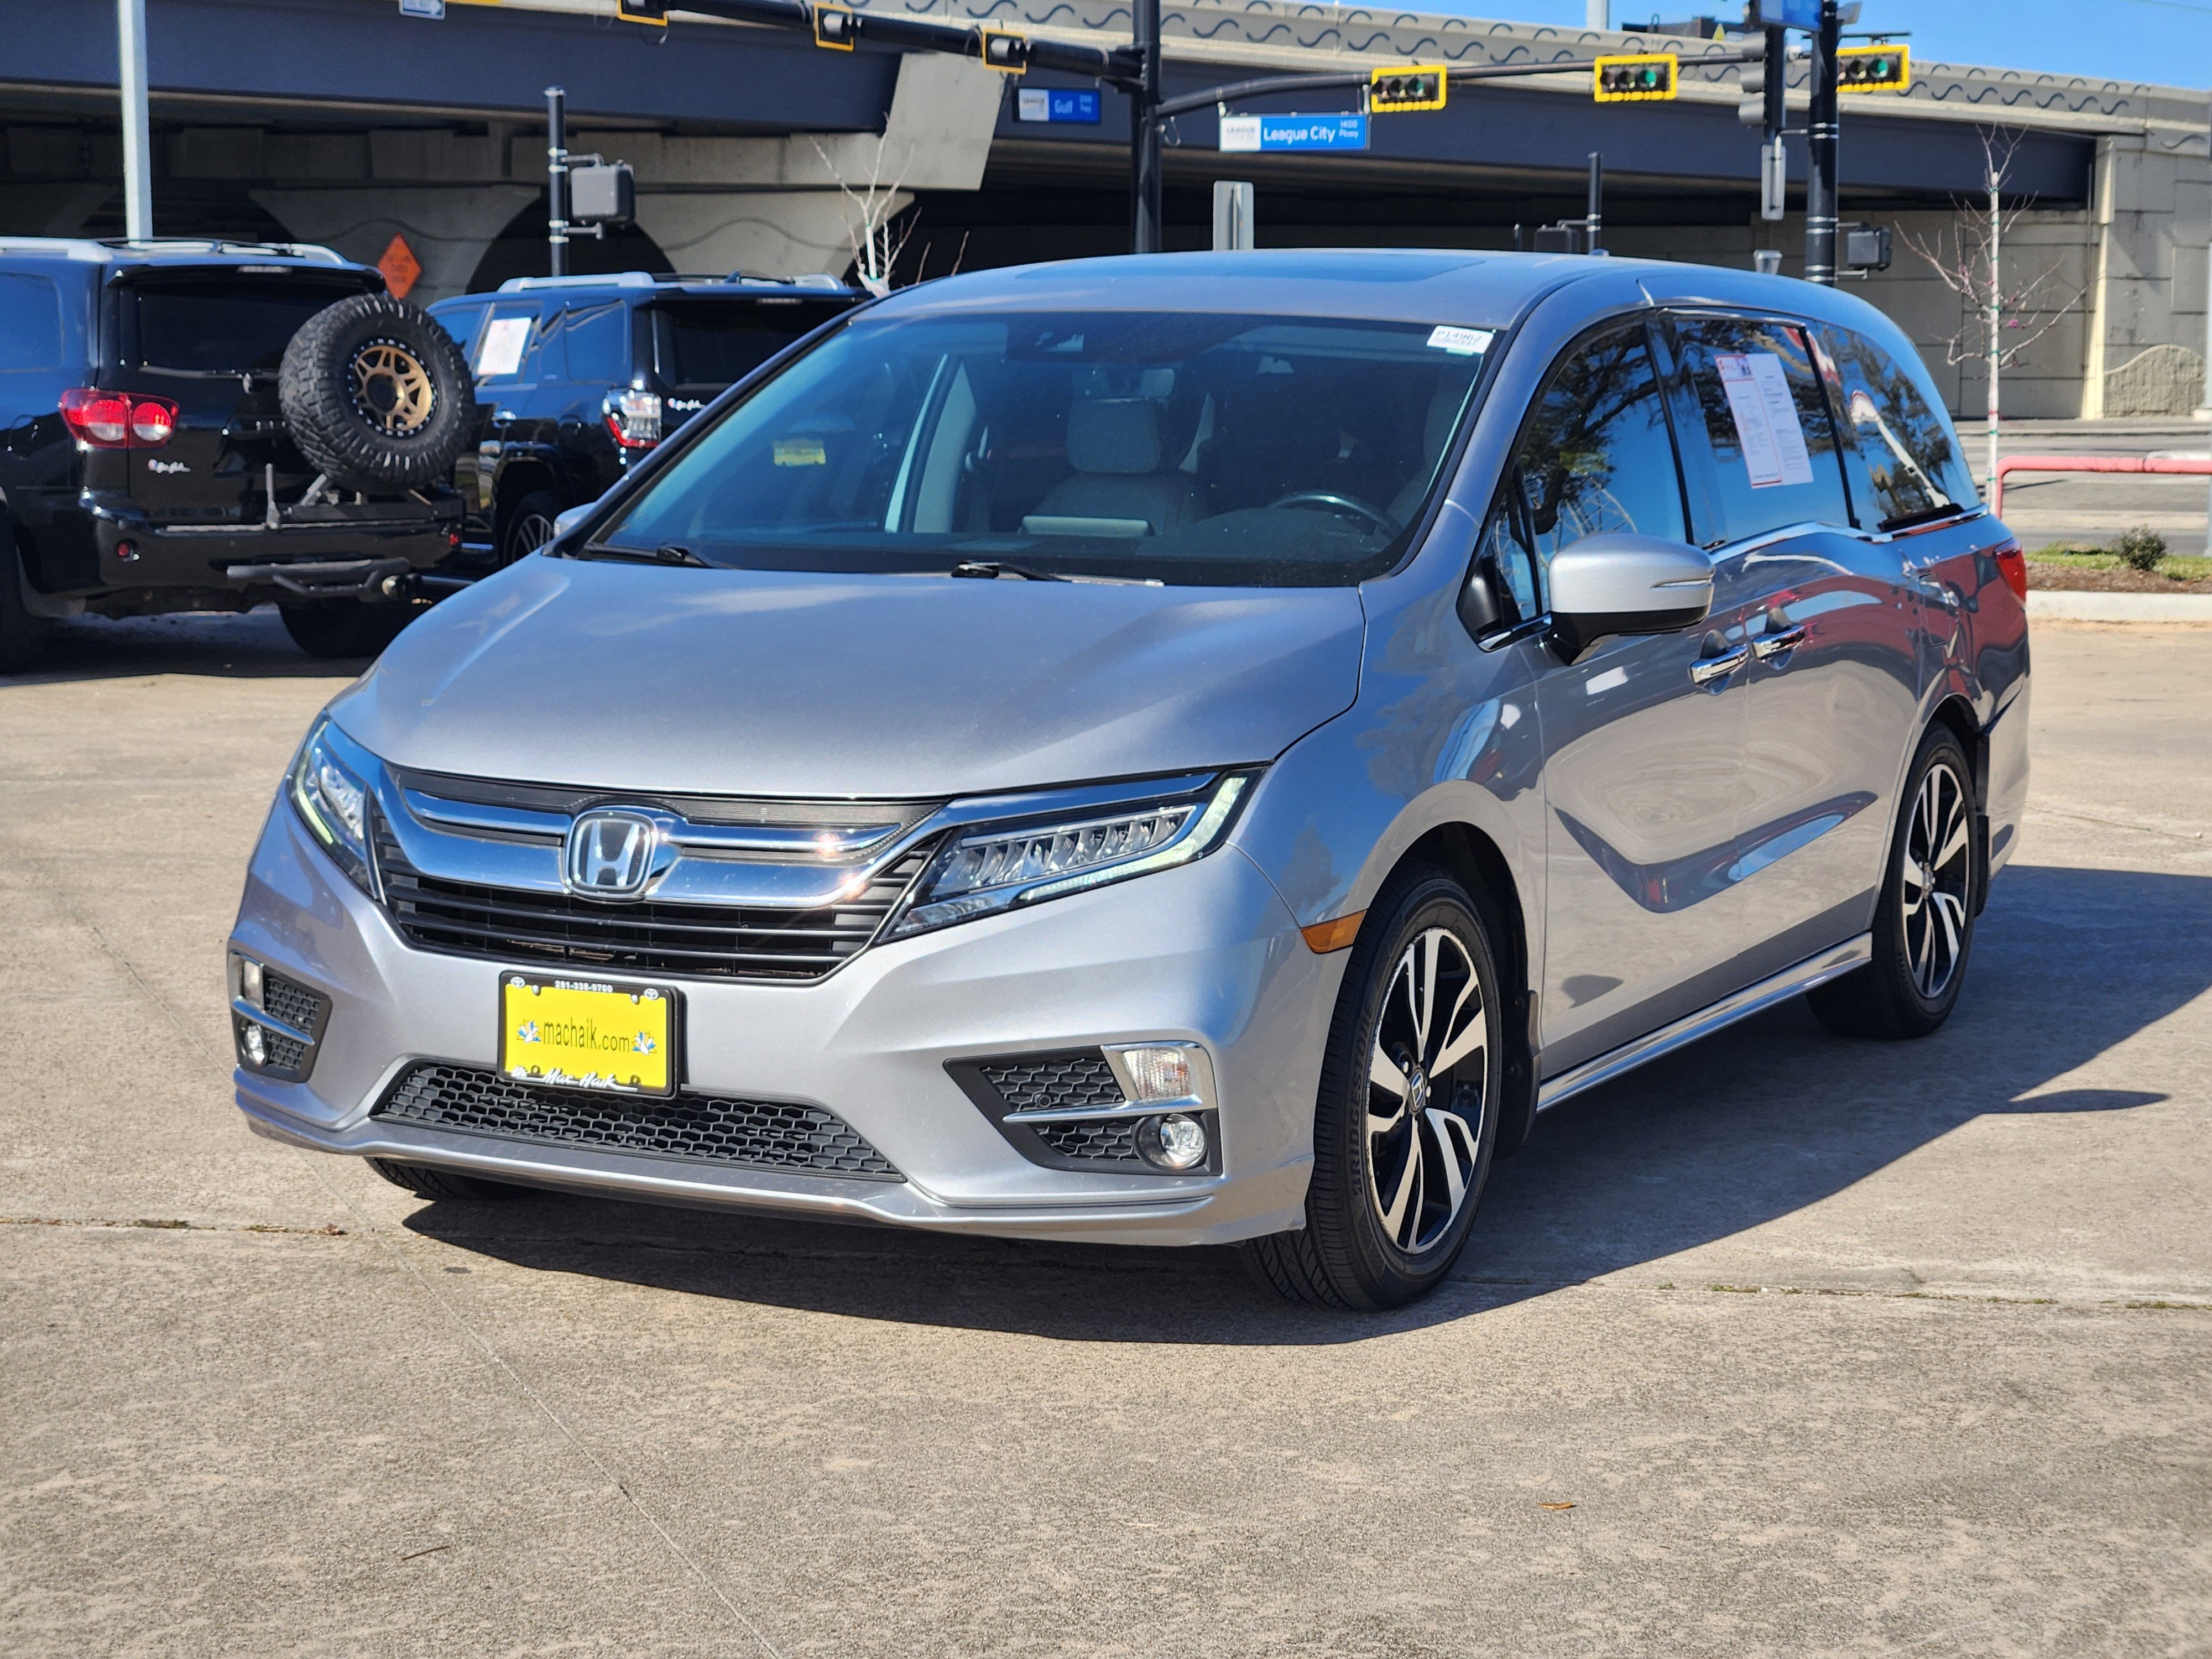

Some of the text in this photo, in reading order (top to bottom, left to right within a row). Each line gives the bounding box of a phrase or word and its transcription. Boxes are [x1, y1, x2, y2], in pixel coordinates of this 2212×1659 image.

[1055, 100, 1073, 113] Gulf
[1264, 127, 1308, 145] League
[1310, 126, 1336, 143] City
[543, 1016, 630, 1052] machaik.com
[540, 1067, 579, 1084] Mac
[1349, 999, 1374, 1196] BRIDGESTONE
